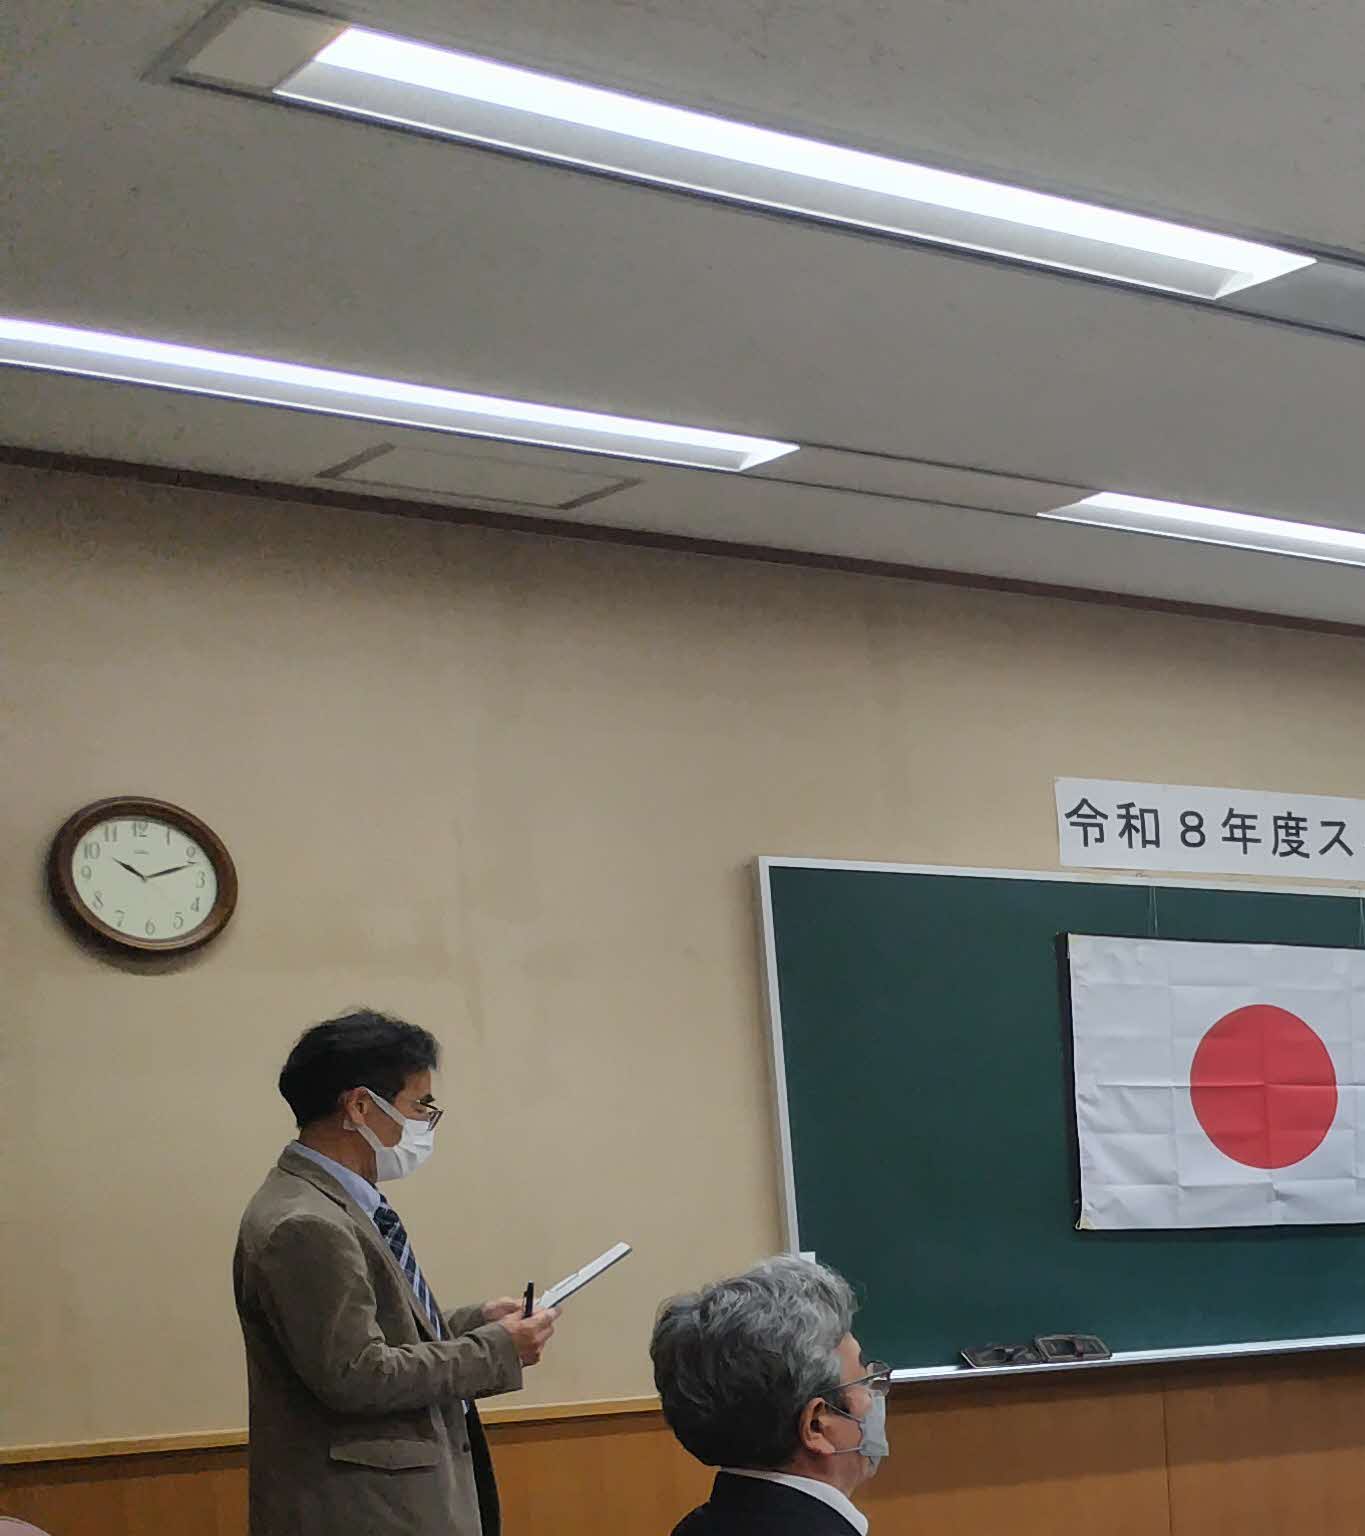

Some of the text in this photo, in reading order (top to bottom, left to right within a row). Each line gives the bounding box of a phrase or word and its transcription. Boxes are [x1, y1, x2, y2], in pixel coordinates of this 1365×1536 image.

[104, 824, 118, 842] 11
[131, 821, 149, 837] 12
[83, 842, 100, 859] 10
[81, 866, 92, 880] 9
[196, 872, 206, 888] 3
[190, 897, 200, 913] 4
[173, 911, 184, 929] 5
[145, 921, 156, 936] 6
